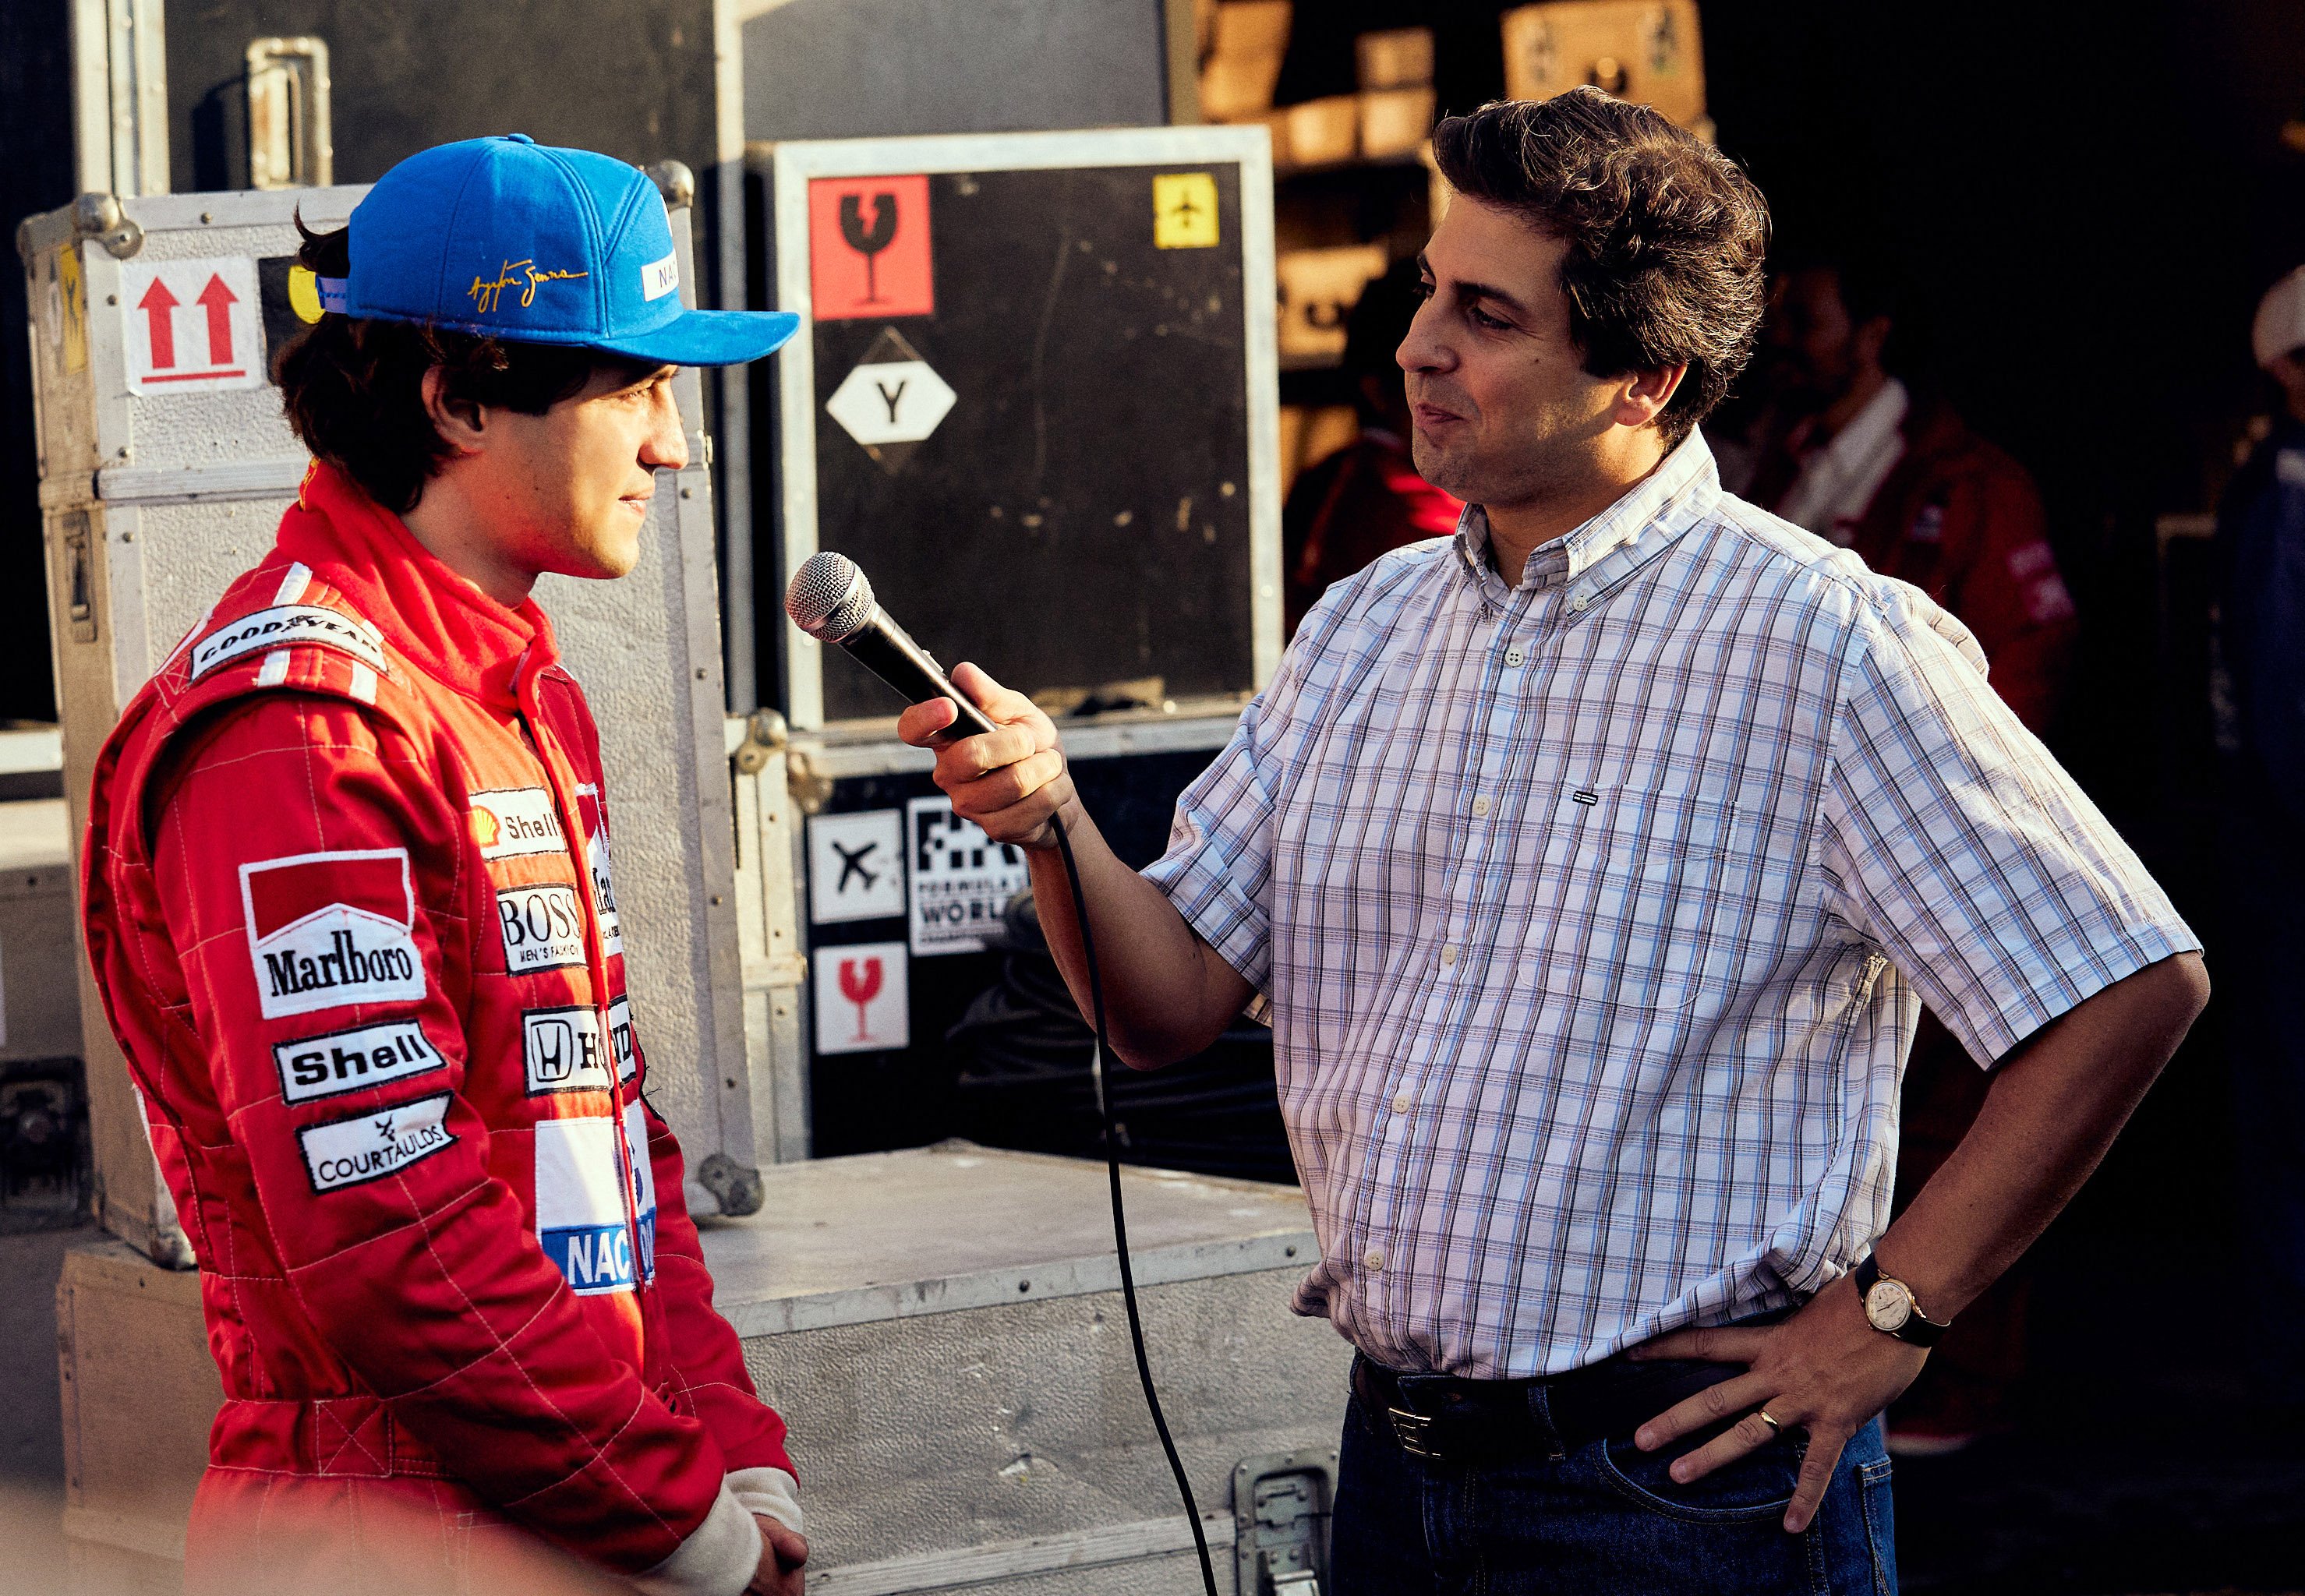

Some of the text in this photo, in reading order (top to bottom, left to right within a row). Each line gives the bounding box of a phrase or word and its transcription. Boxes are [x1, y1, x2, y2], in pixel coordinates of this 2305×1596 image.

[877, 380, 906, 423] Y
[505, 813, 558, 839] Shell
[499, 894, 582, 945] BOSS
[920, 899, 998, 923] WORL
[263, 930, 412, 997] Marlboro
[291, 1033, 428, 1086] Shell
[318, 1125, 444, 1183] COURTAULDS
